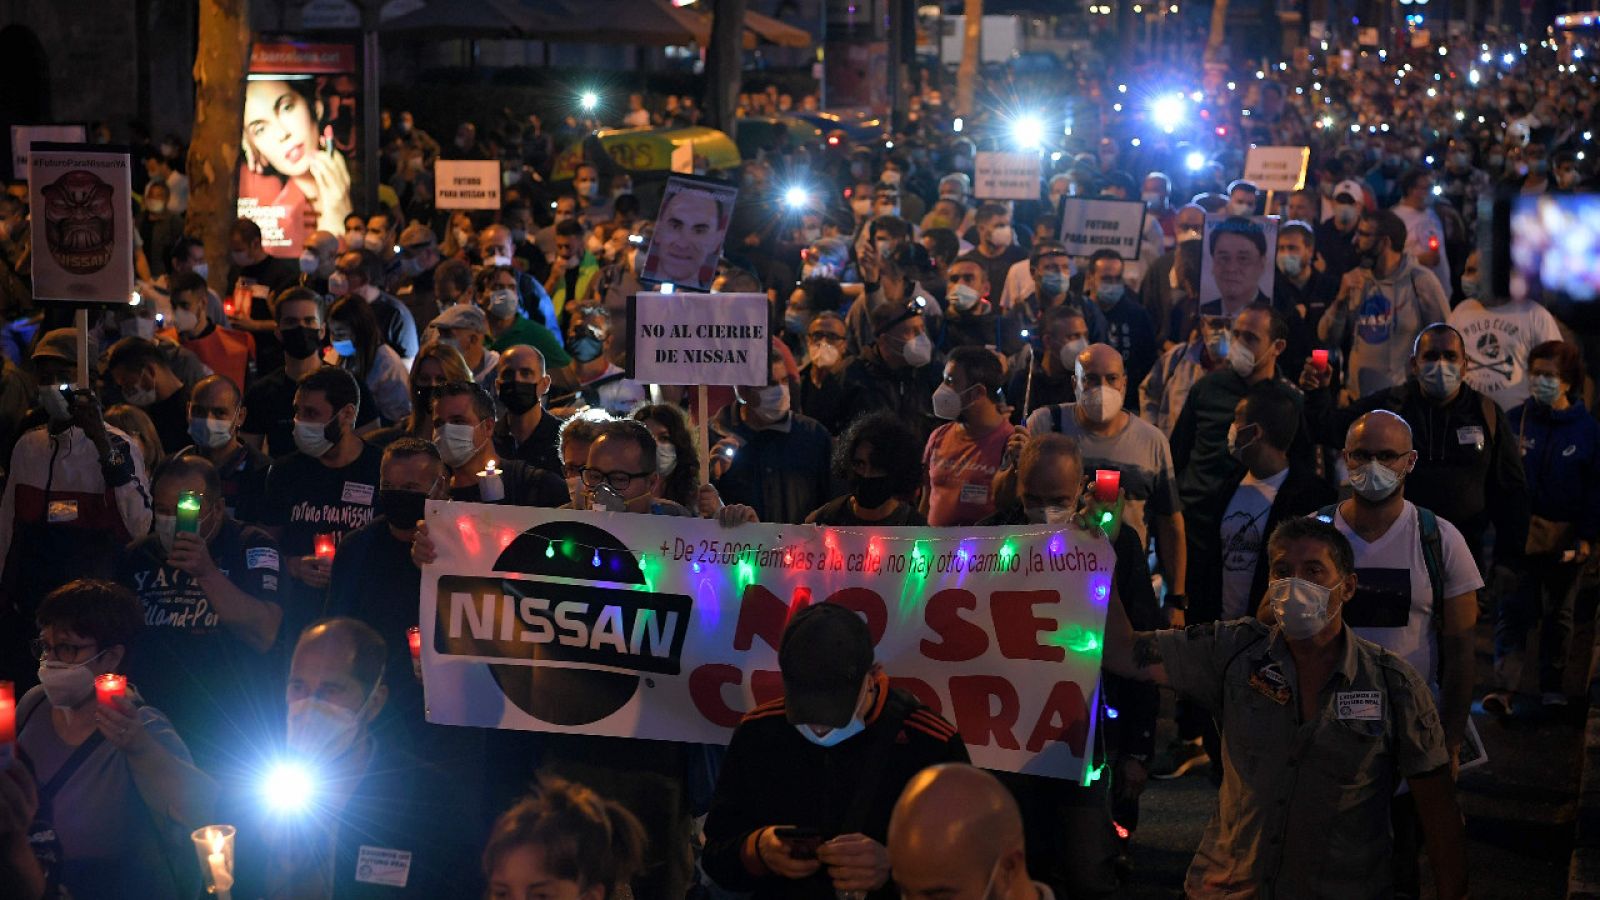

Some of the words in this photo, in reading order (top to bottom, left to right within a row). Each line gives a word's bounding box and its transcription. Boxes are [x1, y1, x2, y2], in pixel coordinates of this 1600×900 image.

[33, 157, 127, 169] #FuturoParaNissanYA
[1085, 219, 1120, 231] FUTURO
[1064, 232, 1087, 244] PARA
[1089, 234, 1121, 245] NISSAN
[641, 324, 665, 339] NO
[670, 324, 692, 339] AL
[695, 324, 764, 339] CIERRE
[655, 349, 678, 364] DE
[683, 349, 749, 364] NISSAN
[673, 537, 695, 562] De
[698, 539, 751, 566] 25.000
[753, 542, 813, 570] familias
[816, 552, 826, 571] a
[828, 546, 845, 571] la
[886, 553, 906, 573] no
[909, 548, 934, 579] hay
[936, 551, 966, 574] otro
[968, 550, 1020, 574] camino
[448, 592, 680, 658] NISSAN
[919, 587, 1066, 662] SE
